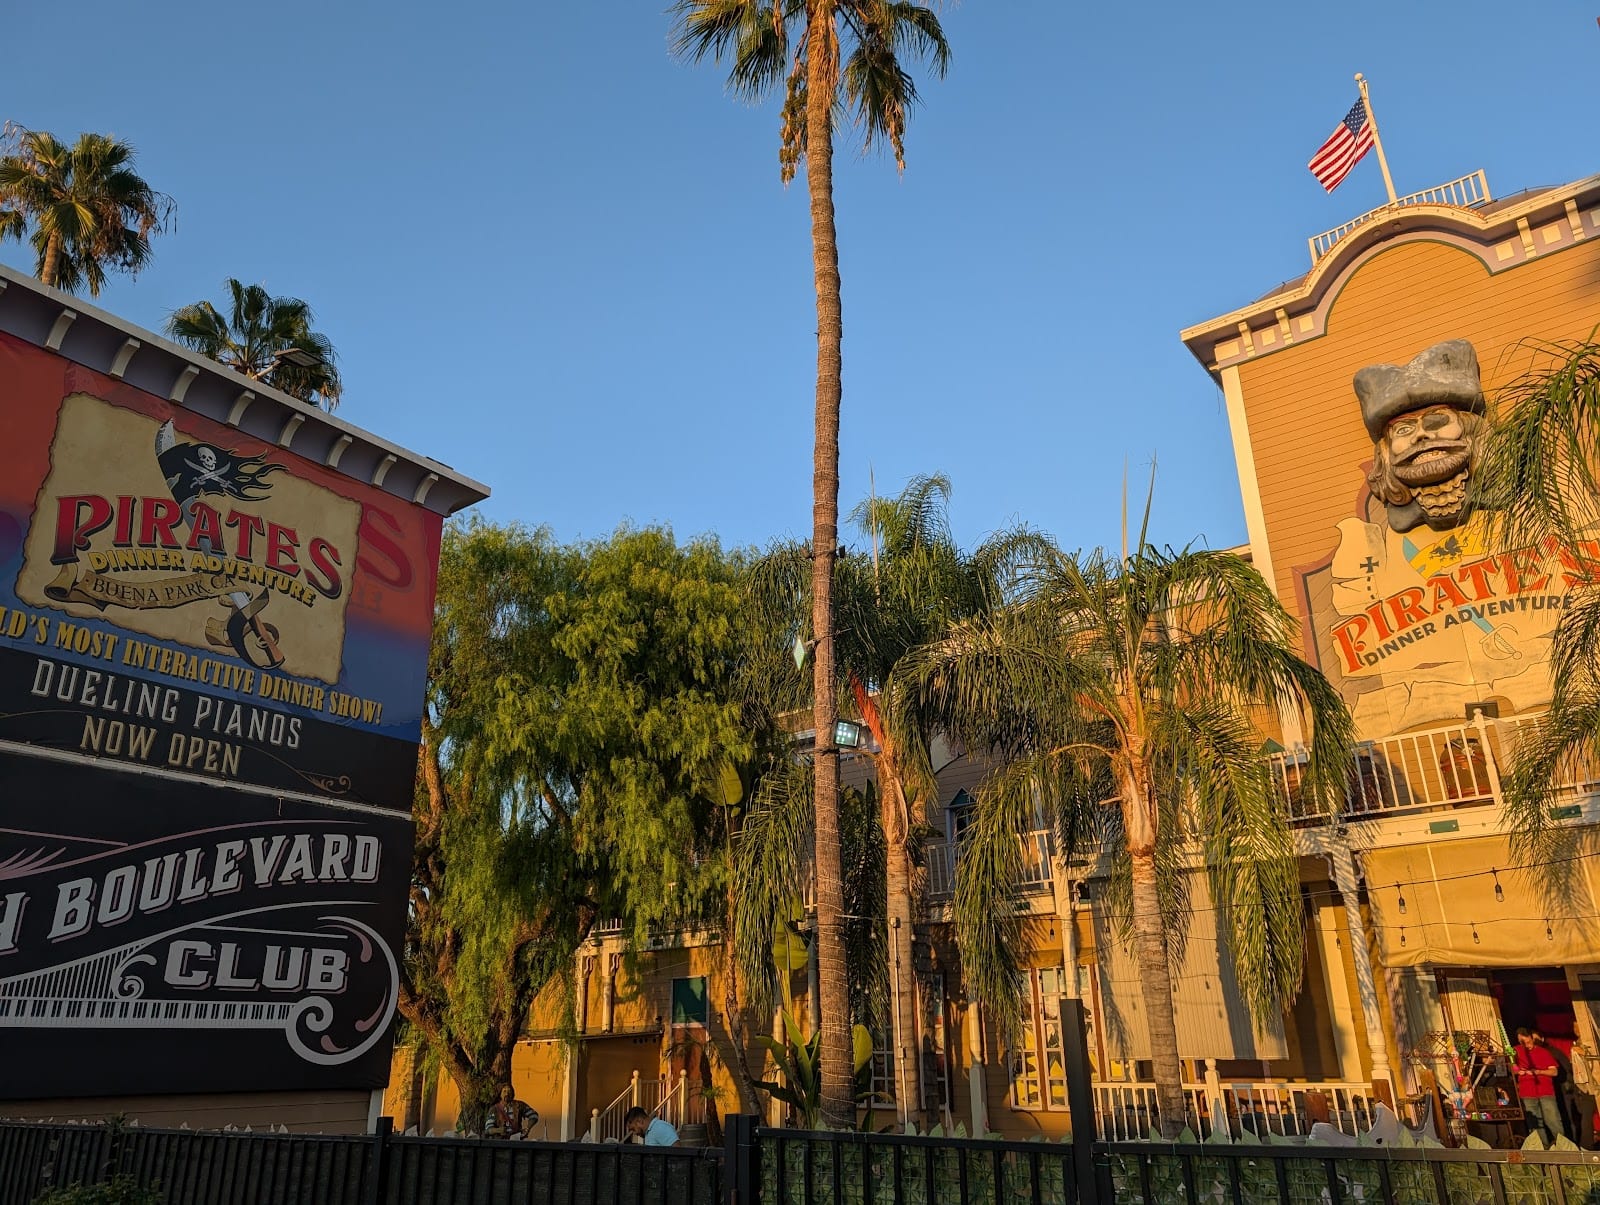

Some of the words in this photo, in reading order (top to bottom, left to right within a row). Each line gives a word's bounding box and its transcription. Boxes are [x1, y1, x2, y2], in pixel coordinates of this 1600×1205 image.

[50, 494, 343, 600] PIRATES
[88, 549, 186, 575] DINNER
[190, 550, 317, 608] ADVENTURE
[92, 577, 161, 602] BUENA
[1363, 621, 1437, 668] DINNER
[1443, 595, 1573, 629] ADVENTURE
[30, 658, 181, 724] DUELING
[194, 695, 303, 750] PIANOS
[55, 621, 119, 661] MOST
[122, 638, 255, 695] INTERACTIVE
[258, 674, 326, 712] DINNER
[327, 689, 384, 726] SHOW!
[80, 715, 158, 762] NOW
[168, 732, 244, 777] OPEN
[47, 833, 383, 943] BOULEVARD
[164, 939, 352, 994] CLUB
